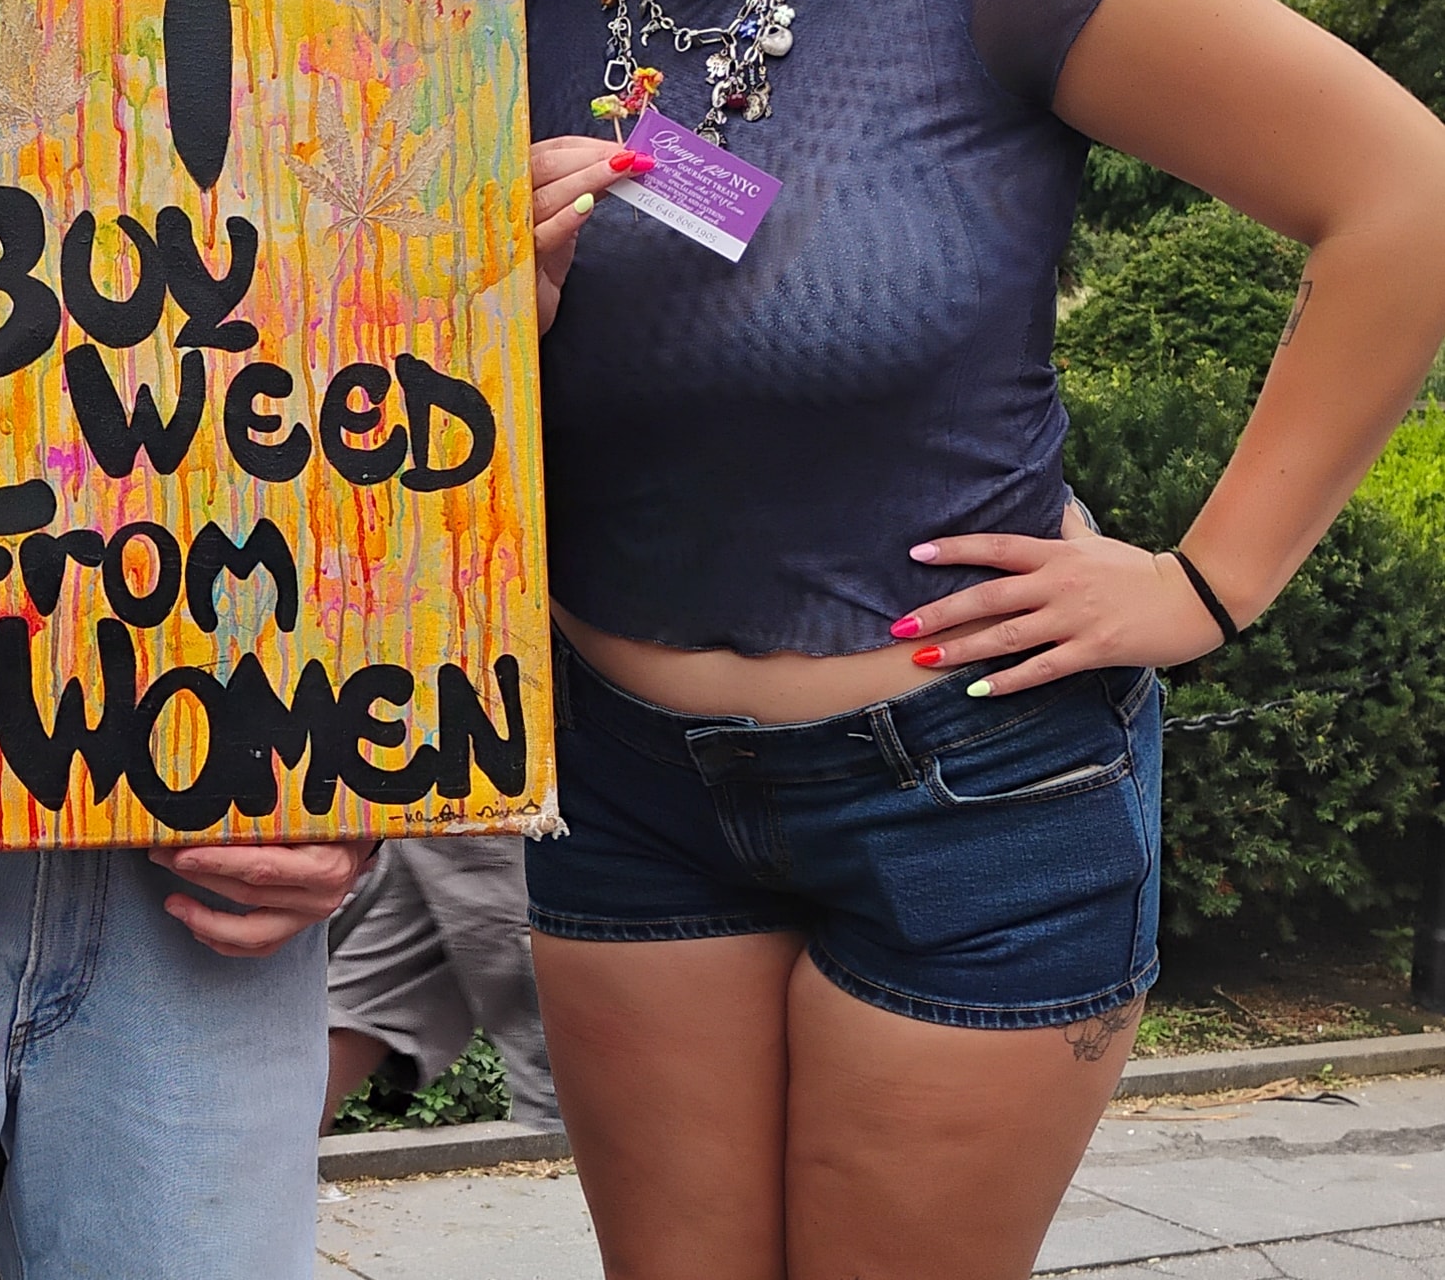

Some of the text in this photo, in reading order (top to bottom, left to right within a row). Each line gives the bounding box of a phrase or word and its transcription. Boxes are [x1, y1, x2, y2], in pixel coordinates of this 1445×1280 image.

[649, 130, 761, 199] Bougie 420 NYC
[675, 162, 739, 201] GOURMET TREATS
[654, 201, 677, 220] 646
[674, 213, 695, 230] 806
[692, 225, 717, 245] 1905
[61, 343, 496, 493] WEED
